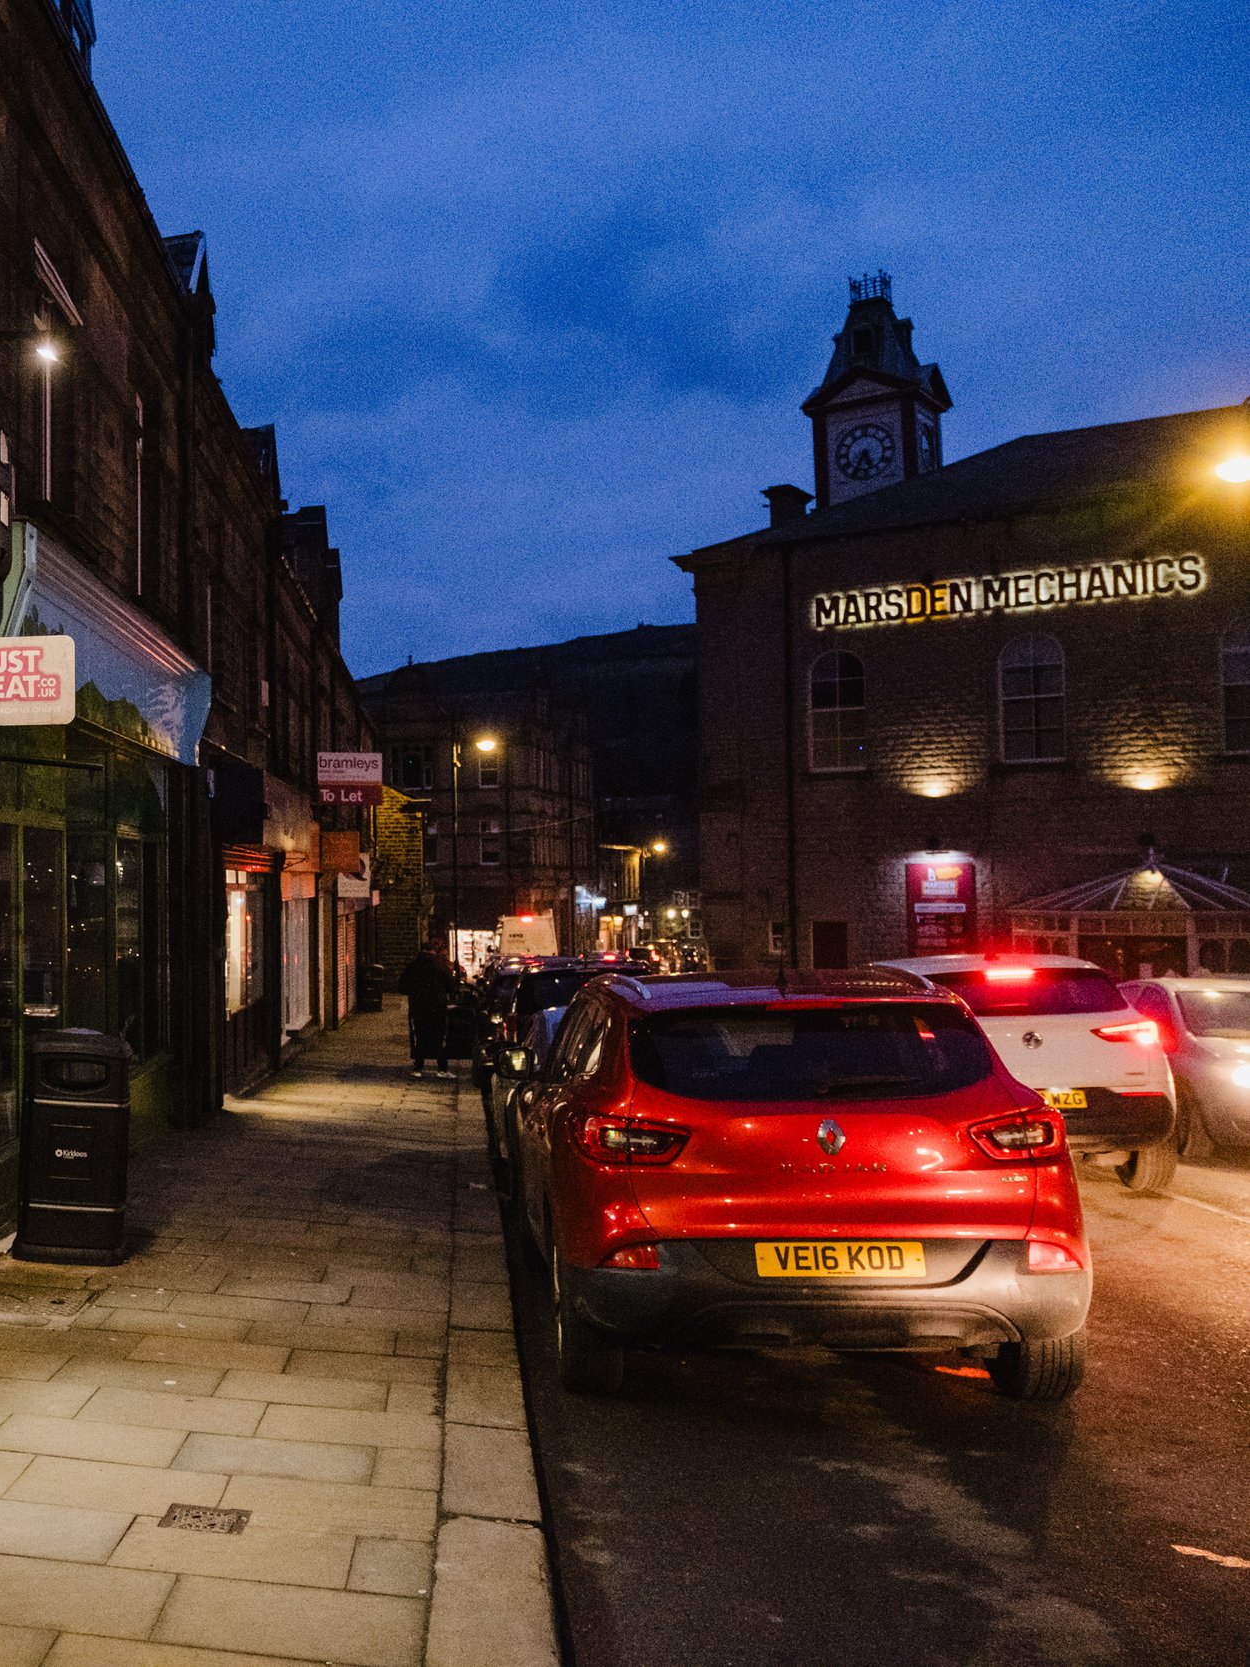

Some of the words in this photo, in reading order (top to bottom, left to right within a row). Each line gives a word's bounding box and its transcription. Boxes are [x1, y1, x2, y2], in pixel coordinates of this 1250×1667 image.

[815, 580, 975, 627] MARSDEN
[983, 555, 1203, 607] MECHANICS
[319, 756, 379, 772] bramleys
[320, 789, 335, 802] To
[340, 790, 363, 802] Let
[1050, 1091, 1083, 1105] WZG
[774, 1245, 839, 1271] VE16
[847, 1246, 905, 1271] KOD
